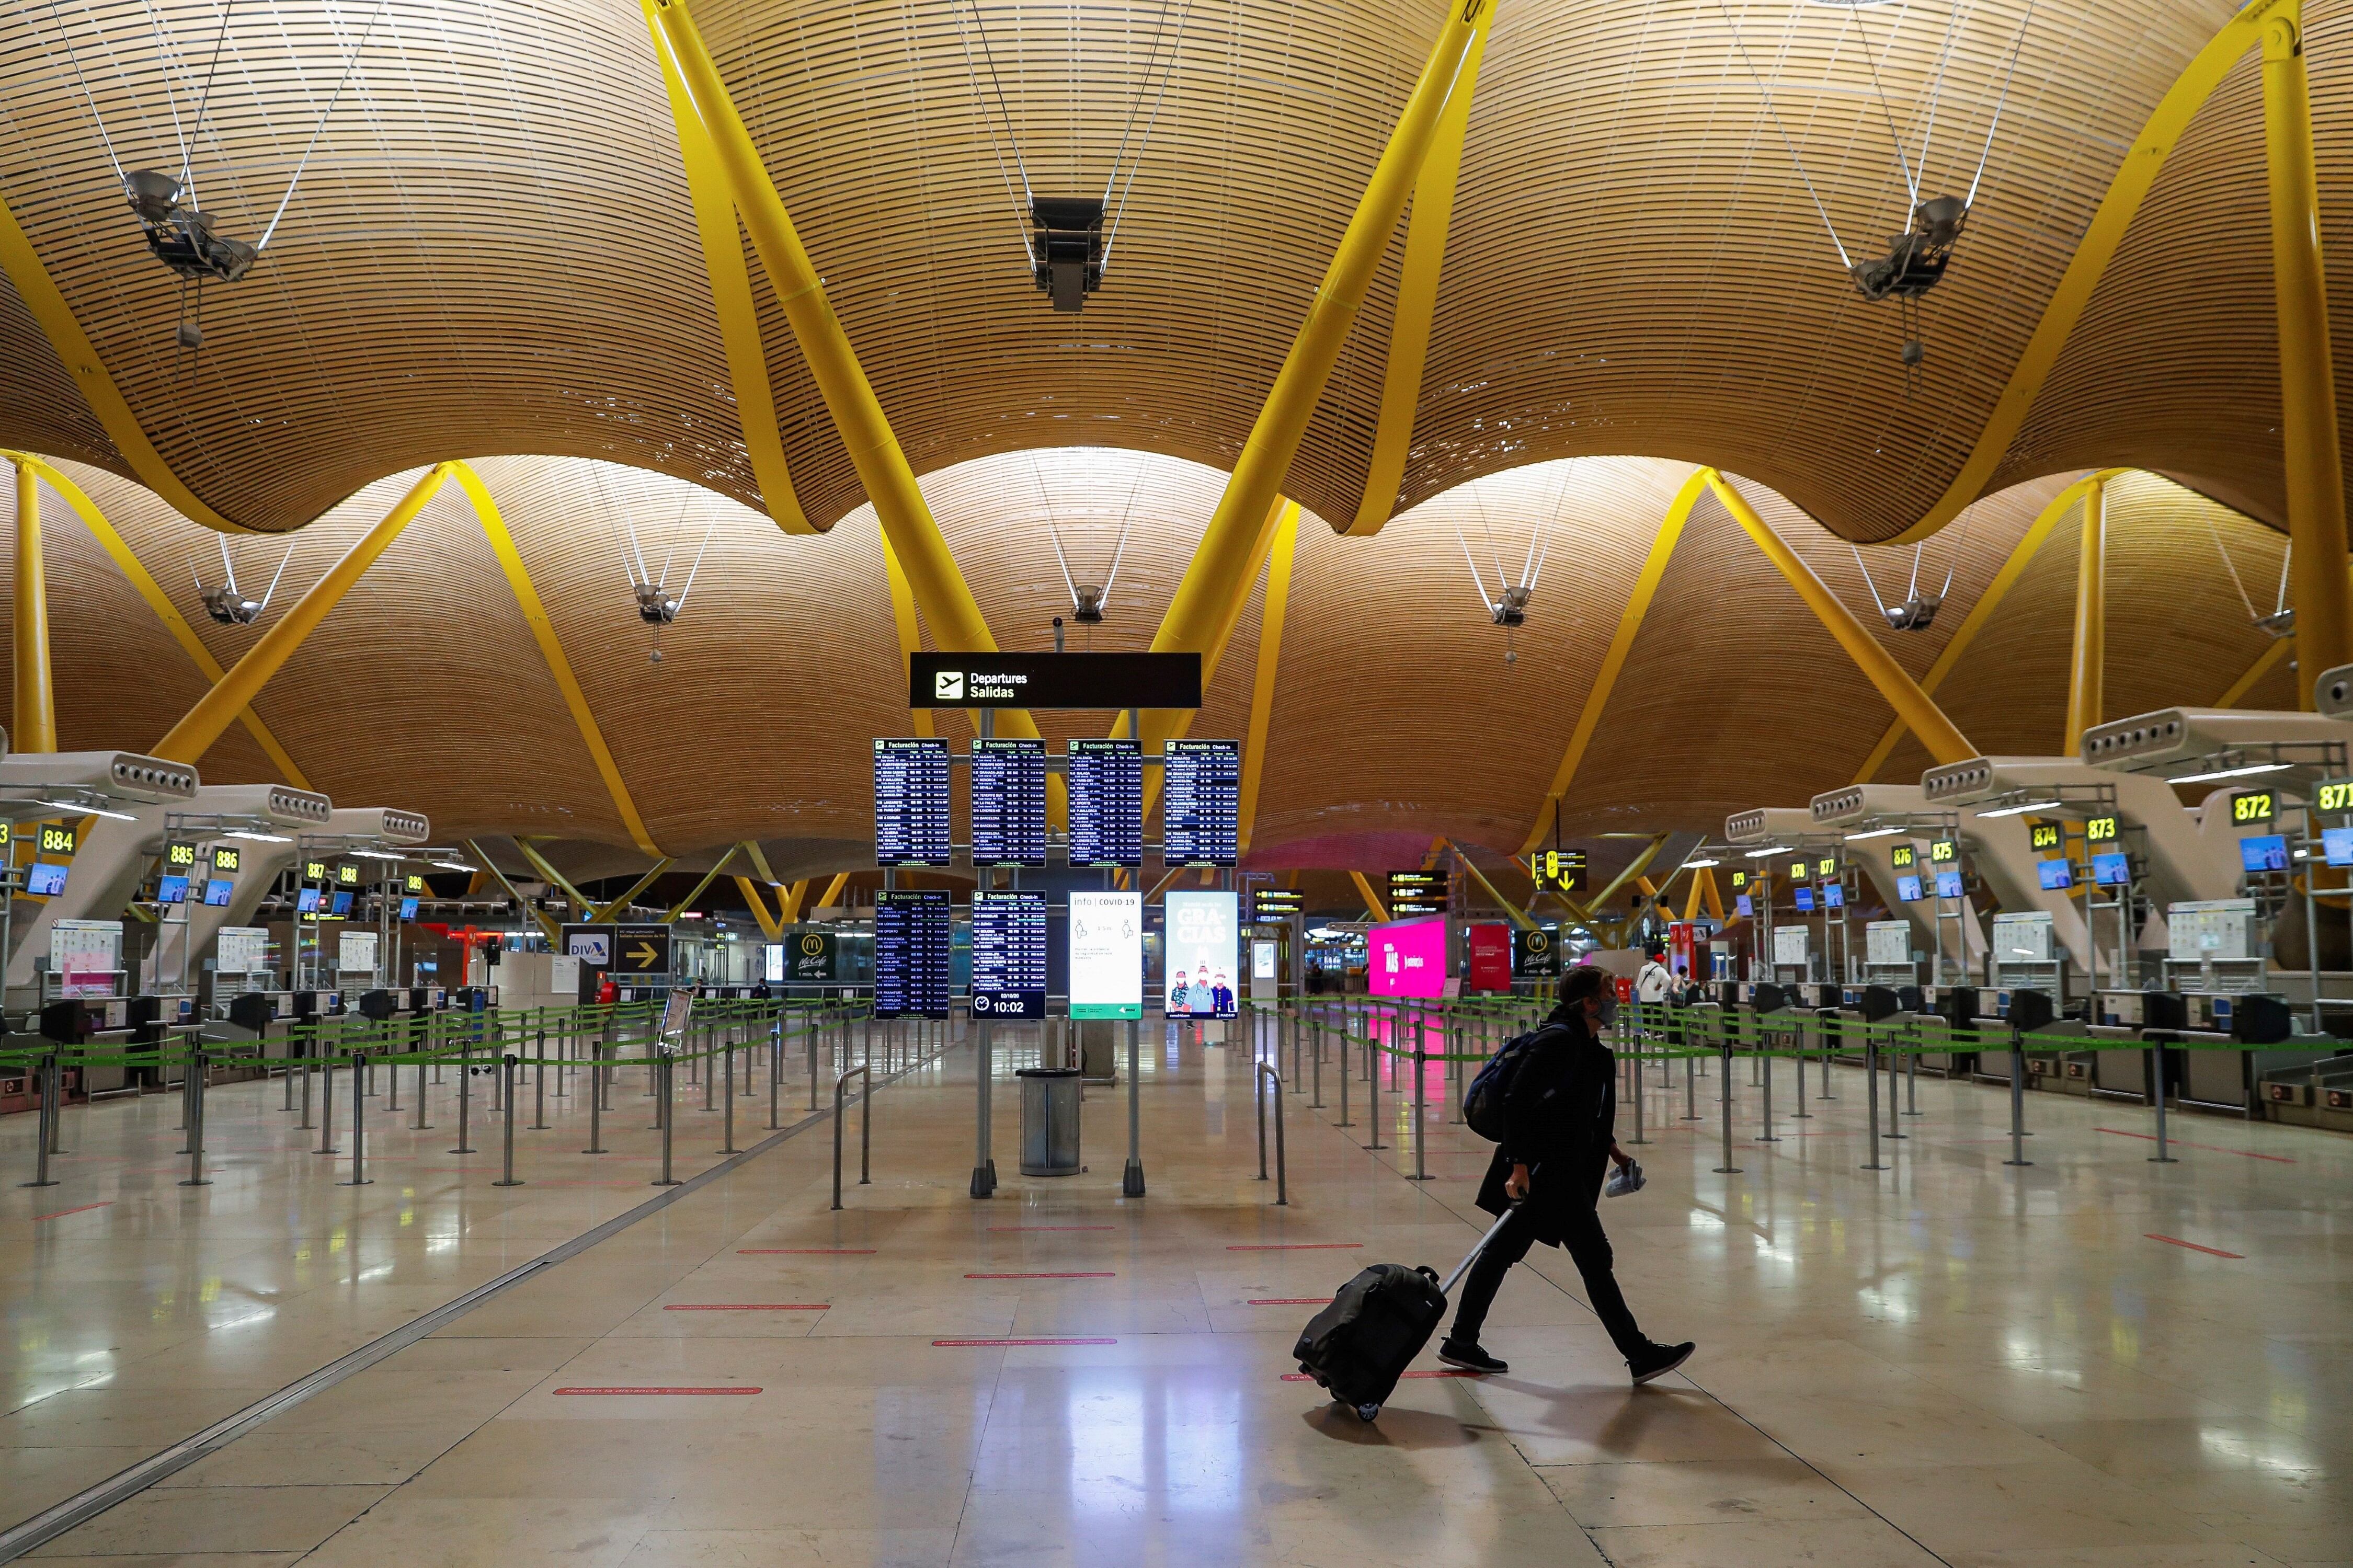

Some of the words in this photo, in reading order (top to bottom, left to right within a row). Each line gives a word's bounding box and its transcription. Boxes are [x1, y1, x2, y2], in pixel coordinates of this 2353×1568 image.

[970, 672, 1027, 686] Departures
[970, 686, 1014, 698] Salidas
[2235, 795, 2271, 820] 872
[2034, 827, 2058, 846] 874
[2088, 818, 2115, 840] 873
[43, 829, 73, 851] 884
[170, 845, 193, 863] 885
[216, 851, 237, 868] 886
[1894, 848, 1912, 865] 876
[1932, 842, 1954, 861] 875
[307, 863, 325, 879] 887
[341, 867, 357, 881] 888
[1791, 863, 1806, 879] 878
[1820, 859, 1834, 875] 877
[408, 876, 422, 889] 889
[1733, 872, 1745, 886] 879
[1075, 897, 1092, 906] info
[1178, 908, 1226, 925] GRA-
[1177, 926, 1226, 943] CIAS
[993, 1002, 1024, 1012] 10:02
